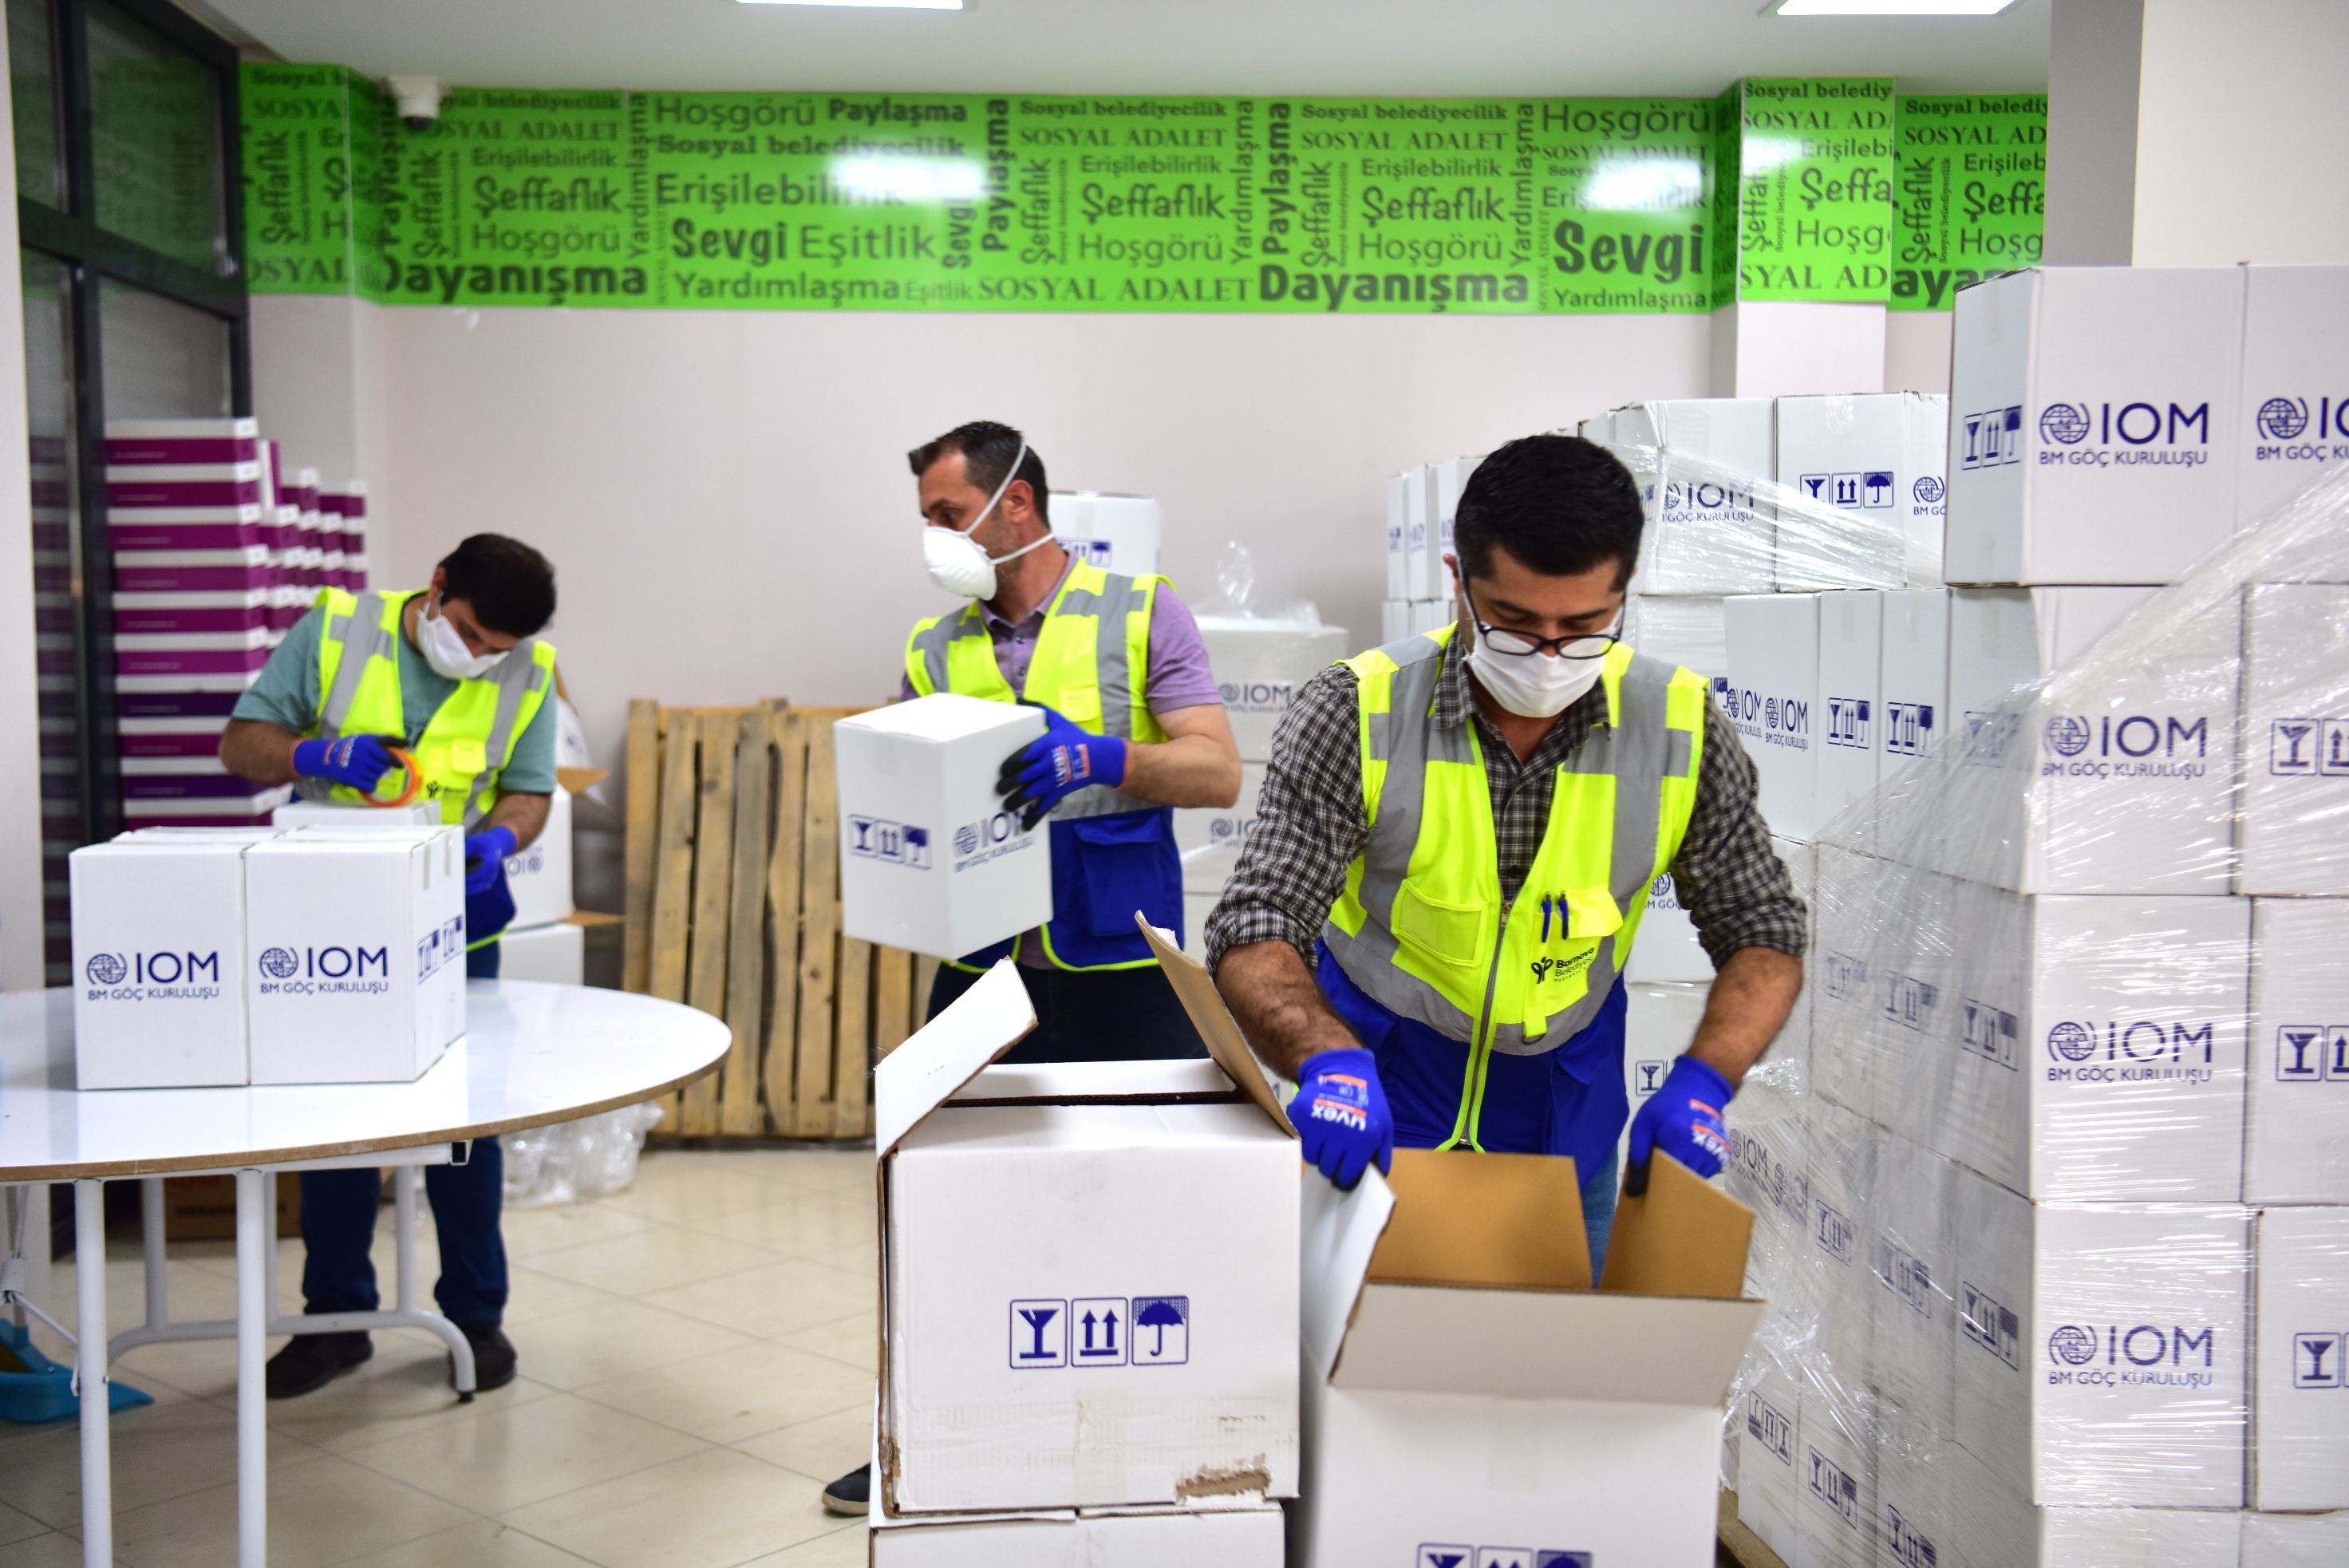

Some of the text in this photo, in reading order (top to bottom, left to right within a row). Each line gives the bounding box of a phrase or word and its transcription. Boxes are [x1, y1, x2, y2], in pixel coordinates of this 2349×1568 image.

[1746, 82, 1810, 102] Sosyal
[656, 97, 968, 132] Hoşgörü Paylaşma
[1018, 100, 1228, 119] Sosyal belediyecilik
[1301, 104, 1509, 124] Sosyal belediyecilik
[1542, 103, 1711, 141] Hoşgörü
[1847, 110, 1894, 131] AD
[1905, 98, 1972, 119] Sosyal
[658, 133, 757, 160] Sosyal
[1019, 127, 1229, 148] SOSYAL ADALET
[1301, 131, 1510, 152] SOSYAL ADALET
[1904, 124, 2047, 146] SOSYAL AD
[981, 97, 1018, 253] Paylaşma
[1079, 154, 1222, 179] Erişilebilirlik
[1260, 101, 1299, 256] Paylaşma
[1360, 156, 1503, 182] Erişilebilirlik
[472, 175, 624, 219] Şeffaflık
[1229, 100, 1261, 267] Yardımlaşma
[1509, 103, 1541, 269] Yardımlaşma
[1799, 167, 1892, 211] Şeffa
[1019, 158, 1058, 266] Şeffaflık
[1081, 183, 1226, 225] Şeffaflık
[1300, 160, 1340, 269] Şeffaflık
[1362, 186, 1506, 228] Şeffaflık
[1901, 156, 1937, 265] Şeffaflık
[471, 223, 621, 260] Hoşgörü
[671, 217, 788, 267] Sevgi
[800, 223, 938, 269] Eşitlik
[1078, 233, 1224, 269] Hoşgörü
[1359, 233, 1504, 269] Hoşgörü
[1553, 219, 1705, 285] Sevgi
[1797, 218, 1892, 255] Hoşg
[673, 271, 901, 308] Yardımlaşma
[977, 275, 1255, 303] SOSYAL ADALET
[1259, 263, 1530, 314] Dayanışma
[1835, 264, 1889, 290] AD
[1553, 288, 1707, 314] Yardımlaşma
[2102, 401, 2209, 446] IOM
[2039, 449, 2209, 469] BM GÖÇ KURULUŞU
[2256, 445, 2281, 460] BM
[2285, 442, 2327, 463] GÖÇ
[1688, 482, 1754, 509] IOM
[1913, 504, 1947, 516] BM GÖ
[1667, 511, 1693, 524] GÖÇ
[1243, 683, 1291, 705] IOM
[1781, 698, 1809, 735] IOM
[1765, 733, 1773, 744] BM
[1773, 732, 1785, 748] GÖÇ
[2101, 715, 2208, 758] IOM
[2068, 760, 2110, 780] GÖÇ
[2114, 762, 2206, 780] KURULUŞU
[1645, 899, 1656, 910] M
[136, 950, 219, 985] IOM
[308, 946, 388, 978] IOM
[1556, 947, 1594, 969] Bornova
[88, 986, 219, 1002] BM GÖÇ KURULUŞU
[260, 980, 389, 997] BM GÖÇ KURULUŞU
[2107, 1021, 2213, 1064] IOM
[2047, 1065, 2213, 1086] BM GÖÇ KURULUŞU
[1743, 1134, 1767, 1179] IOM
[2107, 1324, 2214, 1368] IOM
[2048, 1368, 2213, 1389] BM GÖÇ KURULUŞU
